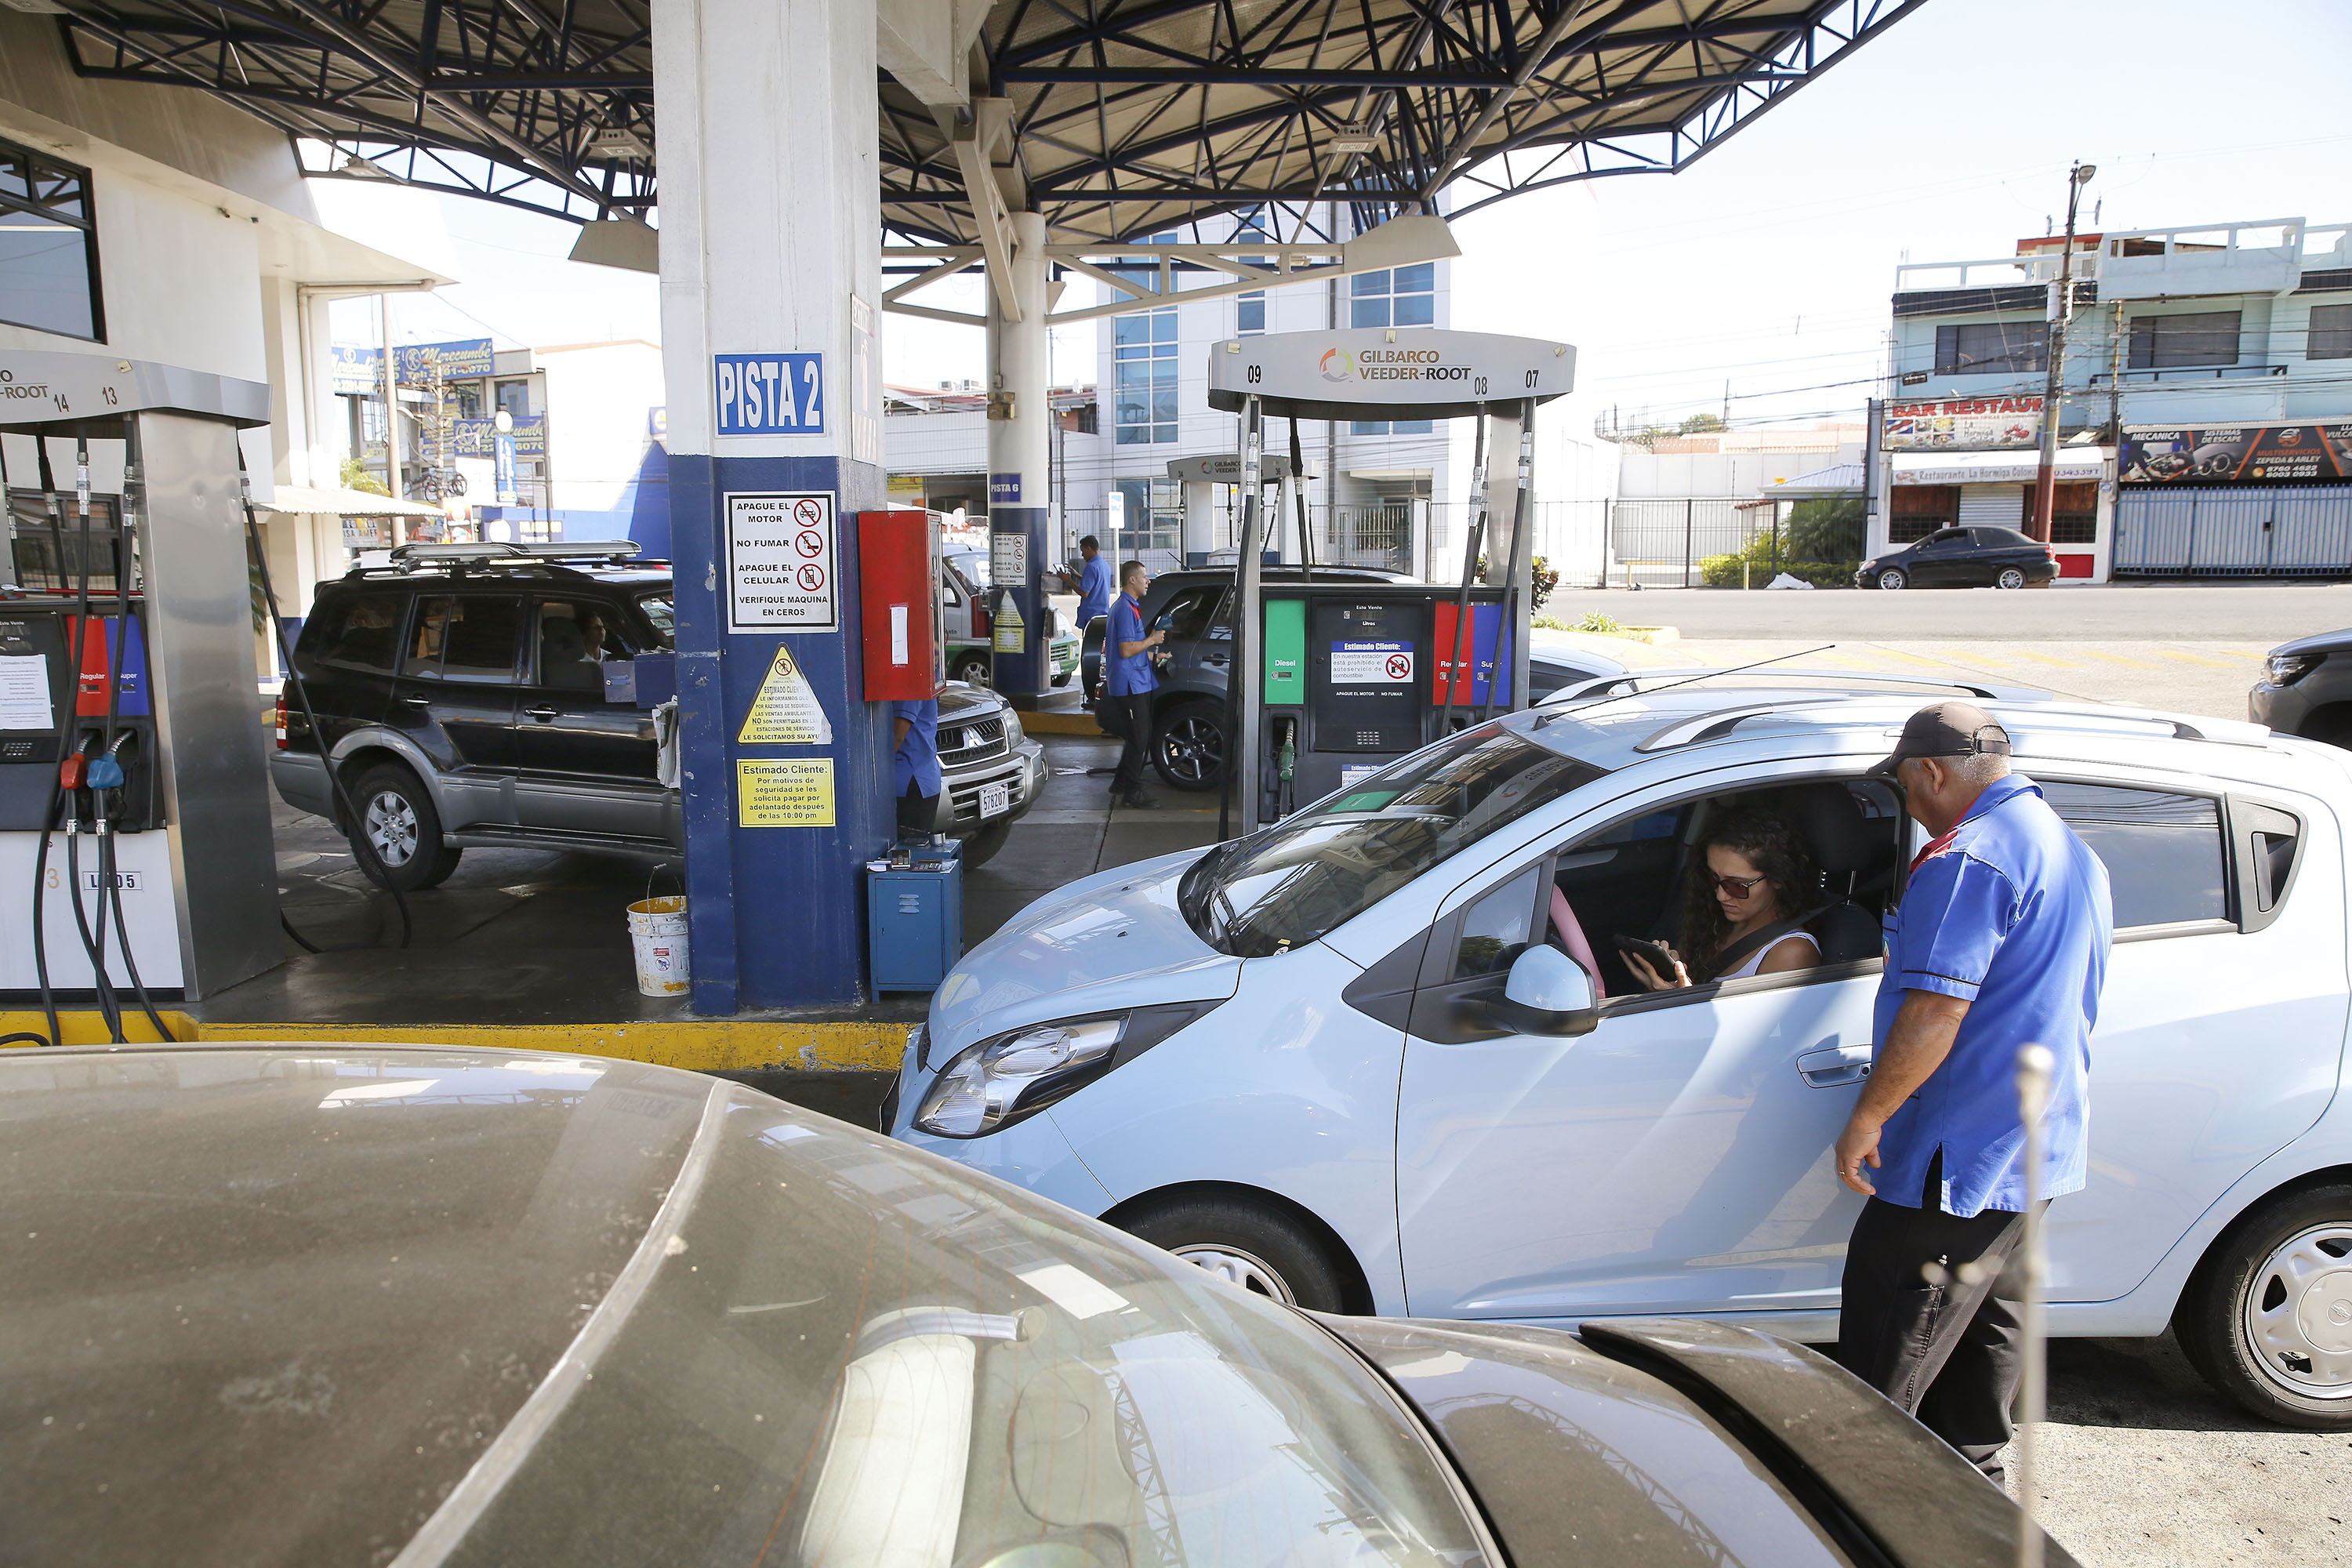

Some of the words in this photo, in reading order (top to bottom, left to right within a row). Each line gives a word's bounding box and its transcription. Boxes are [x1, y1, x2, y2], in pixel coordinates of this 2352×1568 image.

[1359, 350, 1439, 364] GILBARCO
[1247, 365, 1261, 384] 09
[1359, 367, 1472, 381] VEEDER-ROOT
[1525, 369, 1540, 389] 07
[1474, 376, 1488, 395] 08
[102, 387, 118, 405] 13
[718, 361, 798, 428] PISTA
[804, 360, 821, 426] 2
[53, 394, 70, 412] 14
[1892, 404, 1936, 417] BAR
[2131, 432, 2180, 441] MECANICA
[2256, 448, 2321, 456] MULTISERVICIOS
[2294, 455, 2321, 463] ARLEY
[990, 484, 1011, 492] PISTA
[1012, 484, 1018, 492] 6
[743, 765, 788, 774] Estimado
[791, 765, 828, 774] Cliente:
[984, 791, 1006, 811] 578207
[46, 868, 60, 889] 3
